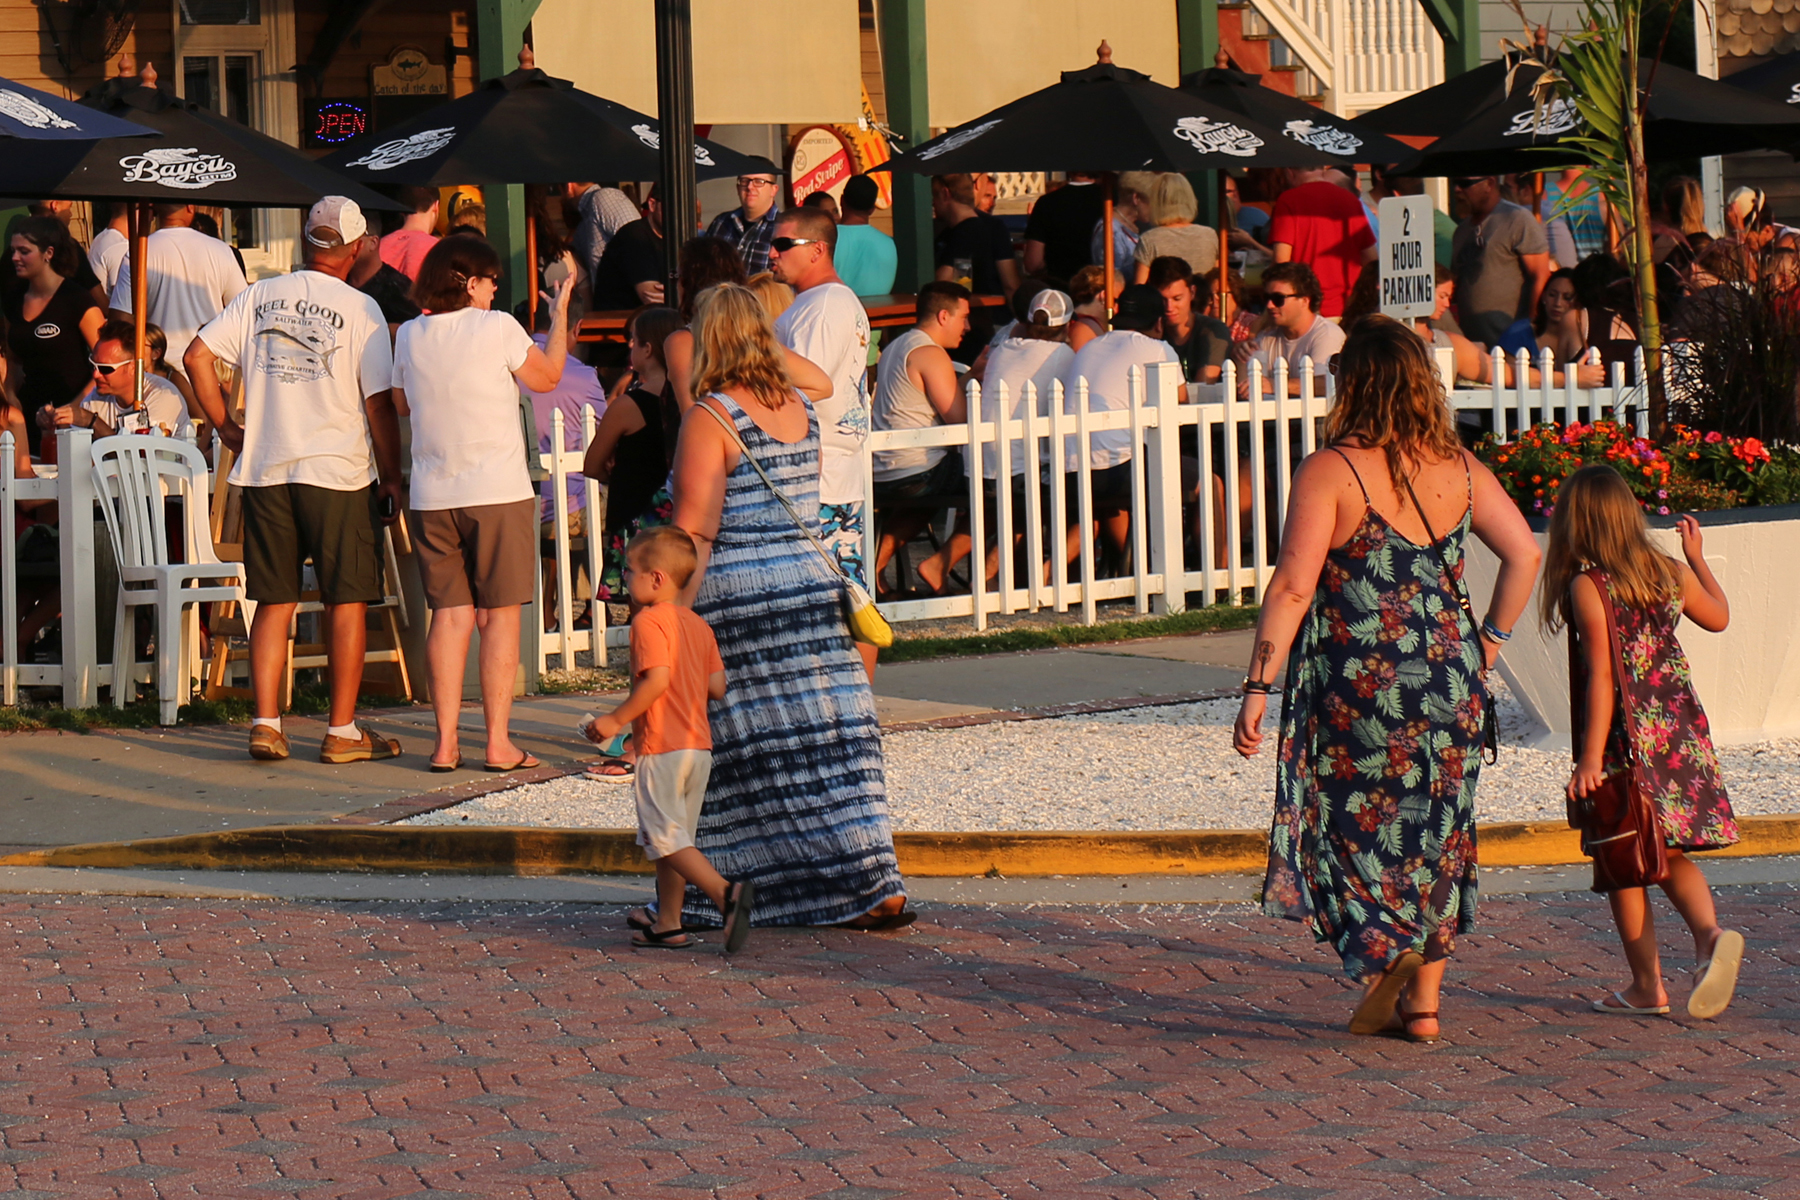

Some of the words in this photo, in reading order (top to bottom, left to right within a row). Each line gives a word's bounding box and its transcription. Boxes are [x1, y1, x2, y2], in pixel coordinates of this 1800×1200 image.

[374, 83, 399, 95] Catch
[401, 82, 410, 95] of
[413, 83, 426, 94] the
[802, 137, 834, 145] IMPORTED
[119, 156, 232, 182] Bayou
[814, 158, 845, 190] Stripe
[1402, 207, 1411, 237] 2
[1391, 240, 1422, 271] HOUR
[1383, 273, 1433, 306] PARKING
[254, 299, 289, 322] REEL
[295, 299, 345, 330] GOOD
[274, 316, 313, 326] SALTWATER
